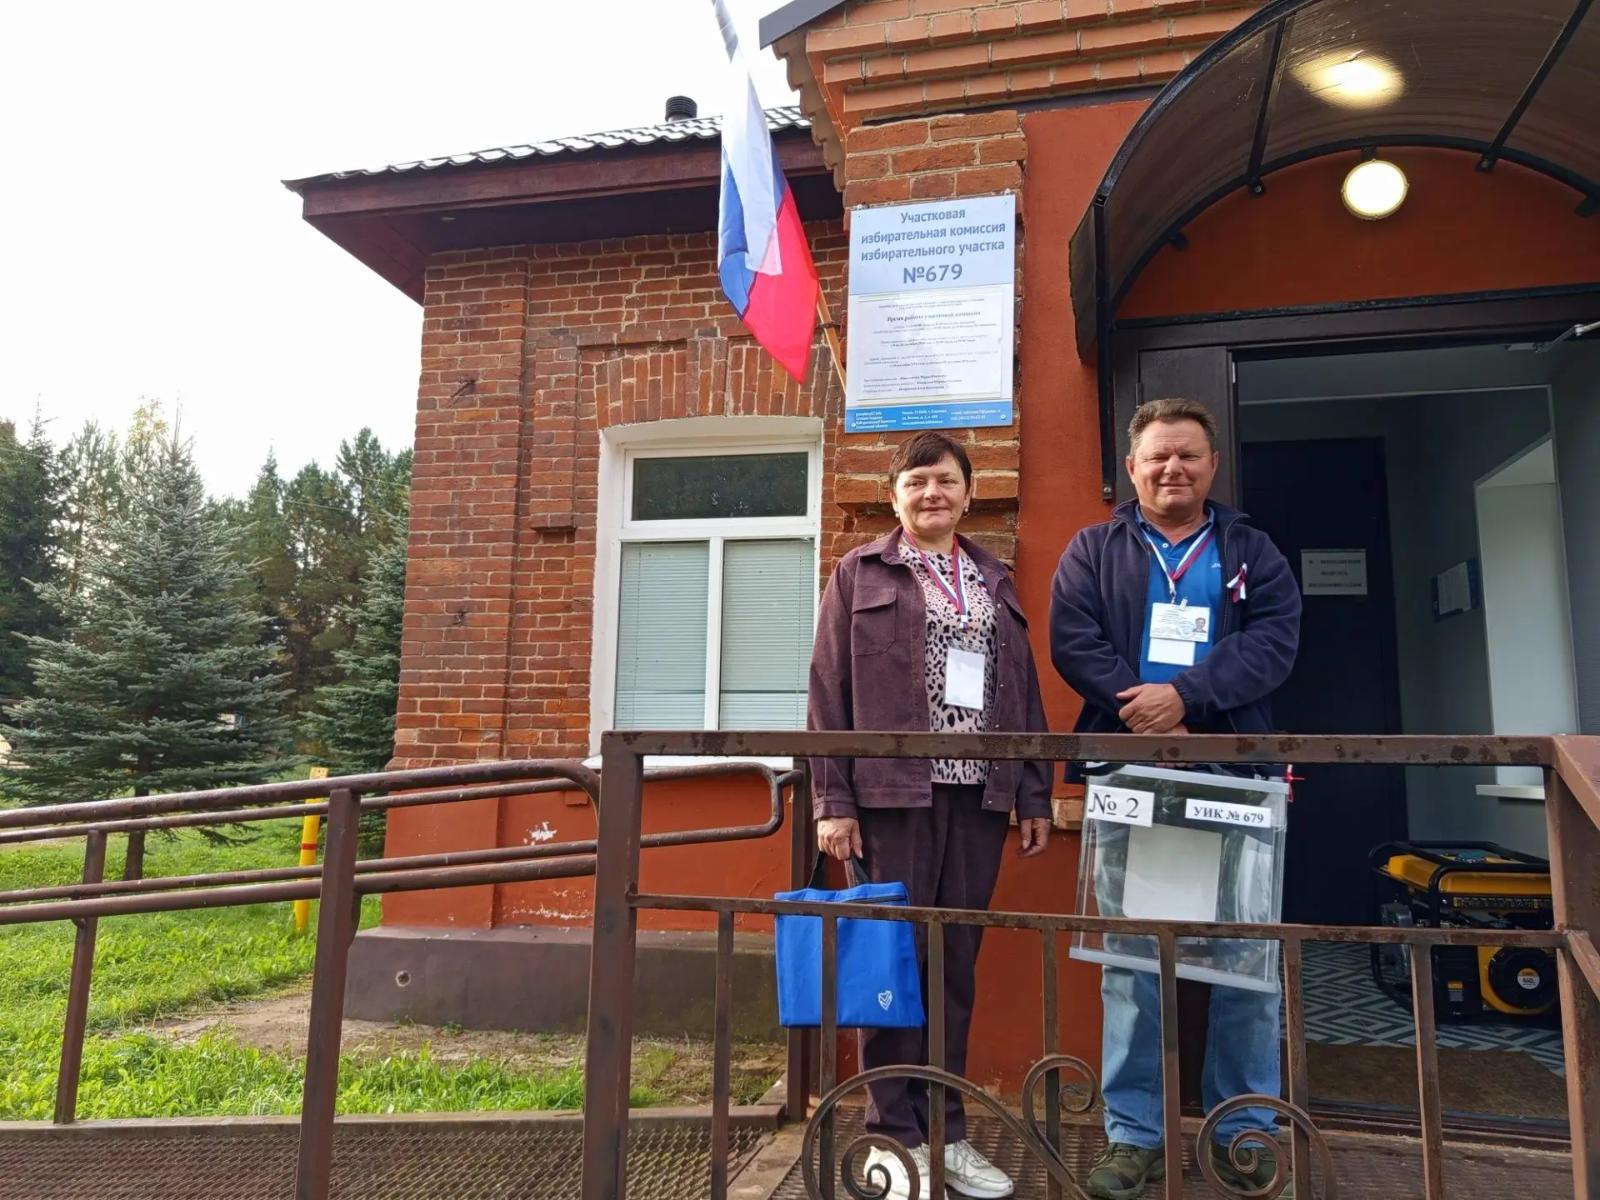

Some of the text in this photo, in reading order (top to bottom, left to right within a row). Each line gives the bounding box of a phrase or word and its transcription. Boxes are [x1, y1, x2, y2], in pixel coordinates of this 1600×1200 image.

[900, 208, 966, 224] Участковая
[861, 222, 1006, 245] избирательная комиссия
[861, 240, 1005, 261] избирательного участка
[903, 263, 963, 284] №679
[1088, 792, 1139, 818] № 2
[1193, 806, 1264, 823] УИК № 679
